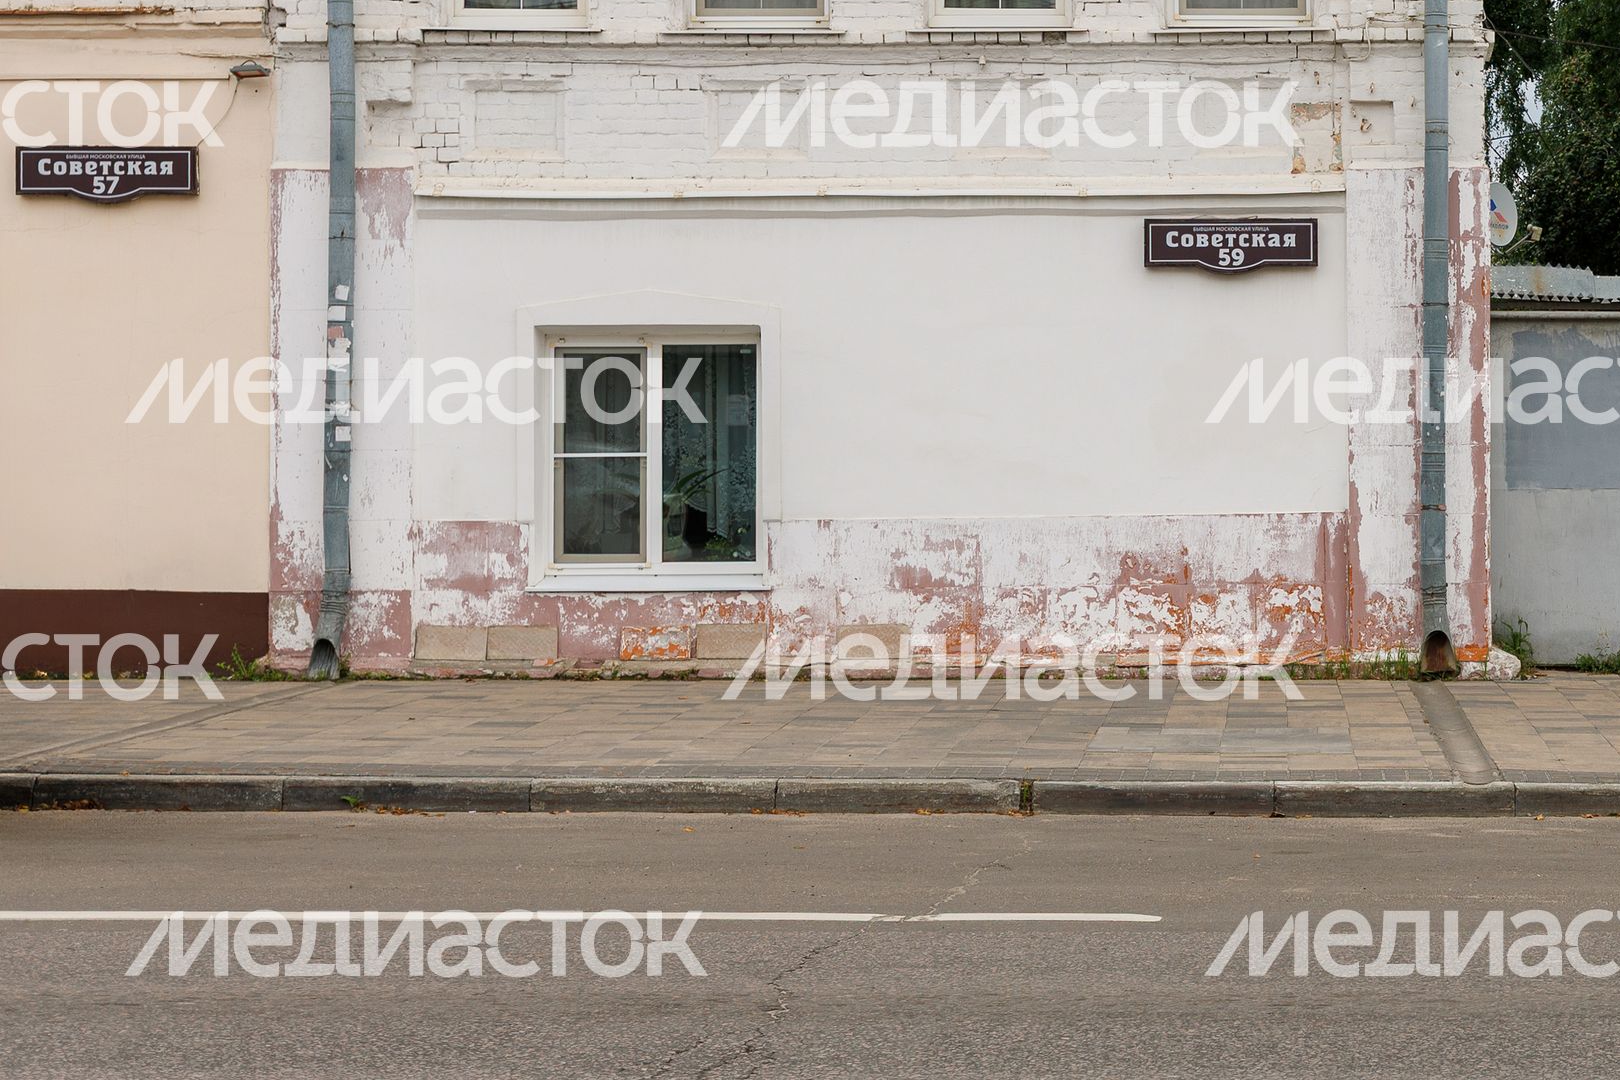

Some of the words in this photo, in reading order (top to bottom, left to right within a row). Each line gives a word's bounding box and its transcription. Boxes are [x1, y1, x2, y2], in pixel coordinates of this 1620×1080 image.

[37, 158, 174, 176] Советская
[92, 176, 120, 195] 57
[1165, 231, 1296, 248] Советская
[1218, 248, 1245, 267] 59
